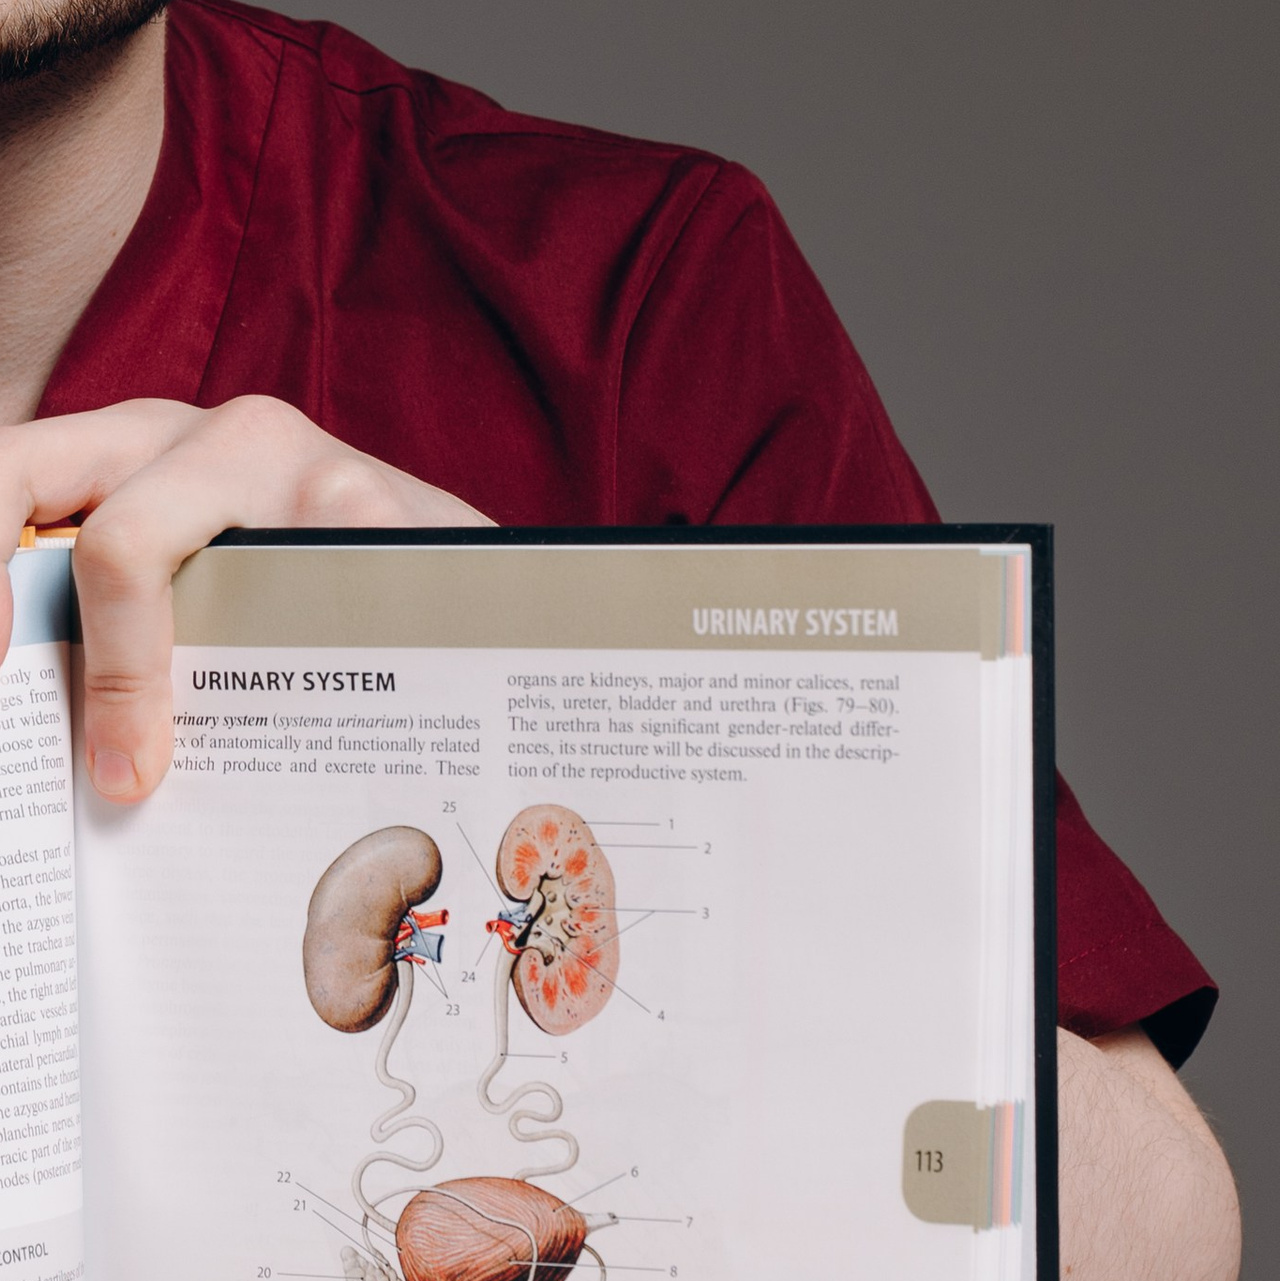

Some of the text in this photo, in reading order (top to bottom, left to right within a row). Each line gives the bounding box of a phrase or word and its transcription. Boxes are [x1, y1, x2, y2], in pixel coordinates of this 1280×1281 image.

[693, 609, 898, 635] URINARY SYSTEM
[193, 671, 395, 691] URINARY SYSTEM
[507, 673, 899, 691] organs are kidneys, major and minor calices, renal
[508, 695, 554, 712] pelvis,
[564, 698, 611, 710] ureter,
[619, 696, 676, 710] bladder
[684, 697, 711, 711] and
[720, 697, 775, 711] urethra
[784, 697, 828, 716] (Figs.
[224, 715, 267, 729] system
[273, 715, 332, 730] (systema
[338, 717, 413, 728] urinarium)
[420, 715, 480, 729] includes
[508, 717, 899, 737] The urethra has significant gender-related differ-
[191, 734, 206, 748] of
[210, 735, 301, 753] anatomically
[306, 736, 332, 750] and
[339, 736, 423, 755] functionally
[431, 738, 479, 752] related
[508, 742, 899, 763] ences, its structure will be discussed in the descrip-
[174, 757, 479, 775] which produce and excrete urine. These
[509, 763, 747, 783] tion of the reproductive system.
[443, 801, 456, 813] 25
[704, 842, 711, 854] 2
[702, 907, 709, 919] 3
[462, 971, 475, 982] 24
[446, 1004, 460, 1016] 23
[658, 1010, 665, 1021] 4
[561, 1051, 568, 1063] 5
[916, 1150, 943, 1173] 113
[277, 1171, 290, 1183] 22
[631, 1166, 639, 1178] 6
[294, 1199, 305, 1211] 21
[686, 1216, 693, 1228] 7
[258, 1267, 271, 1278] 20
[670, 1266, 677, 1277] 8
